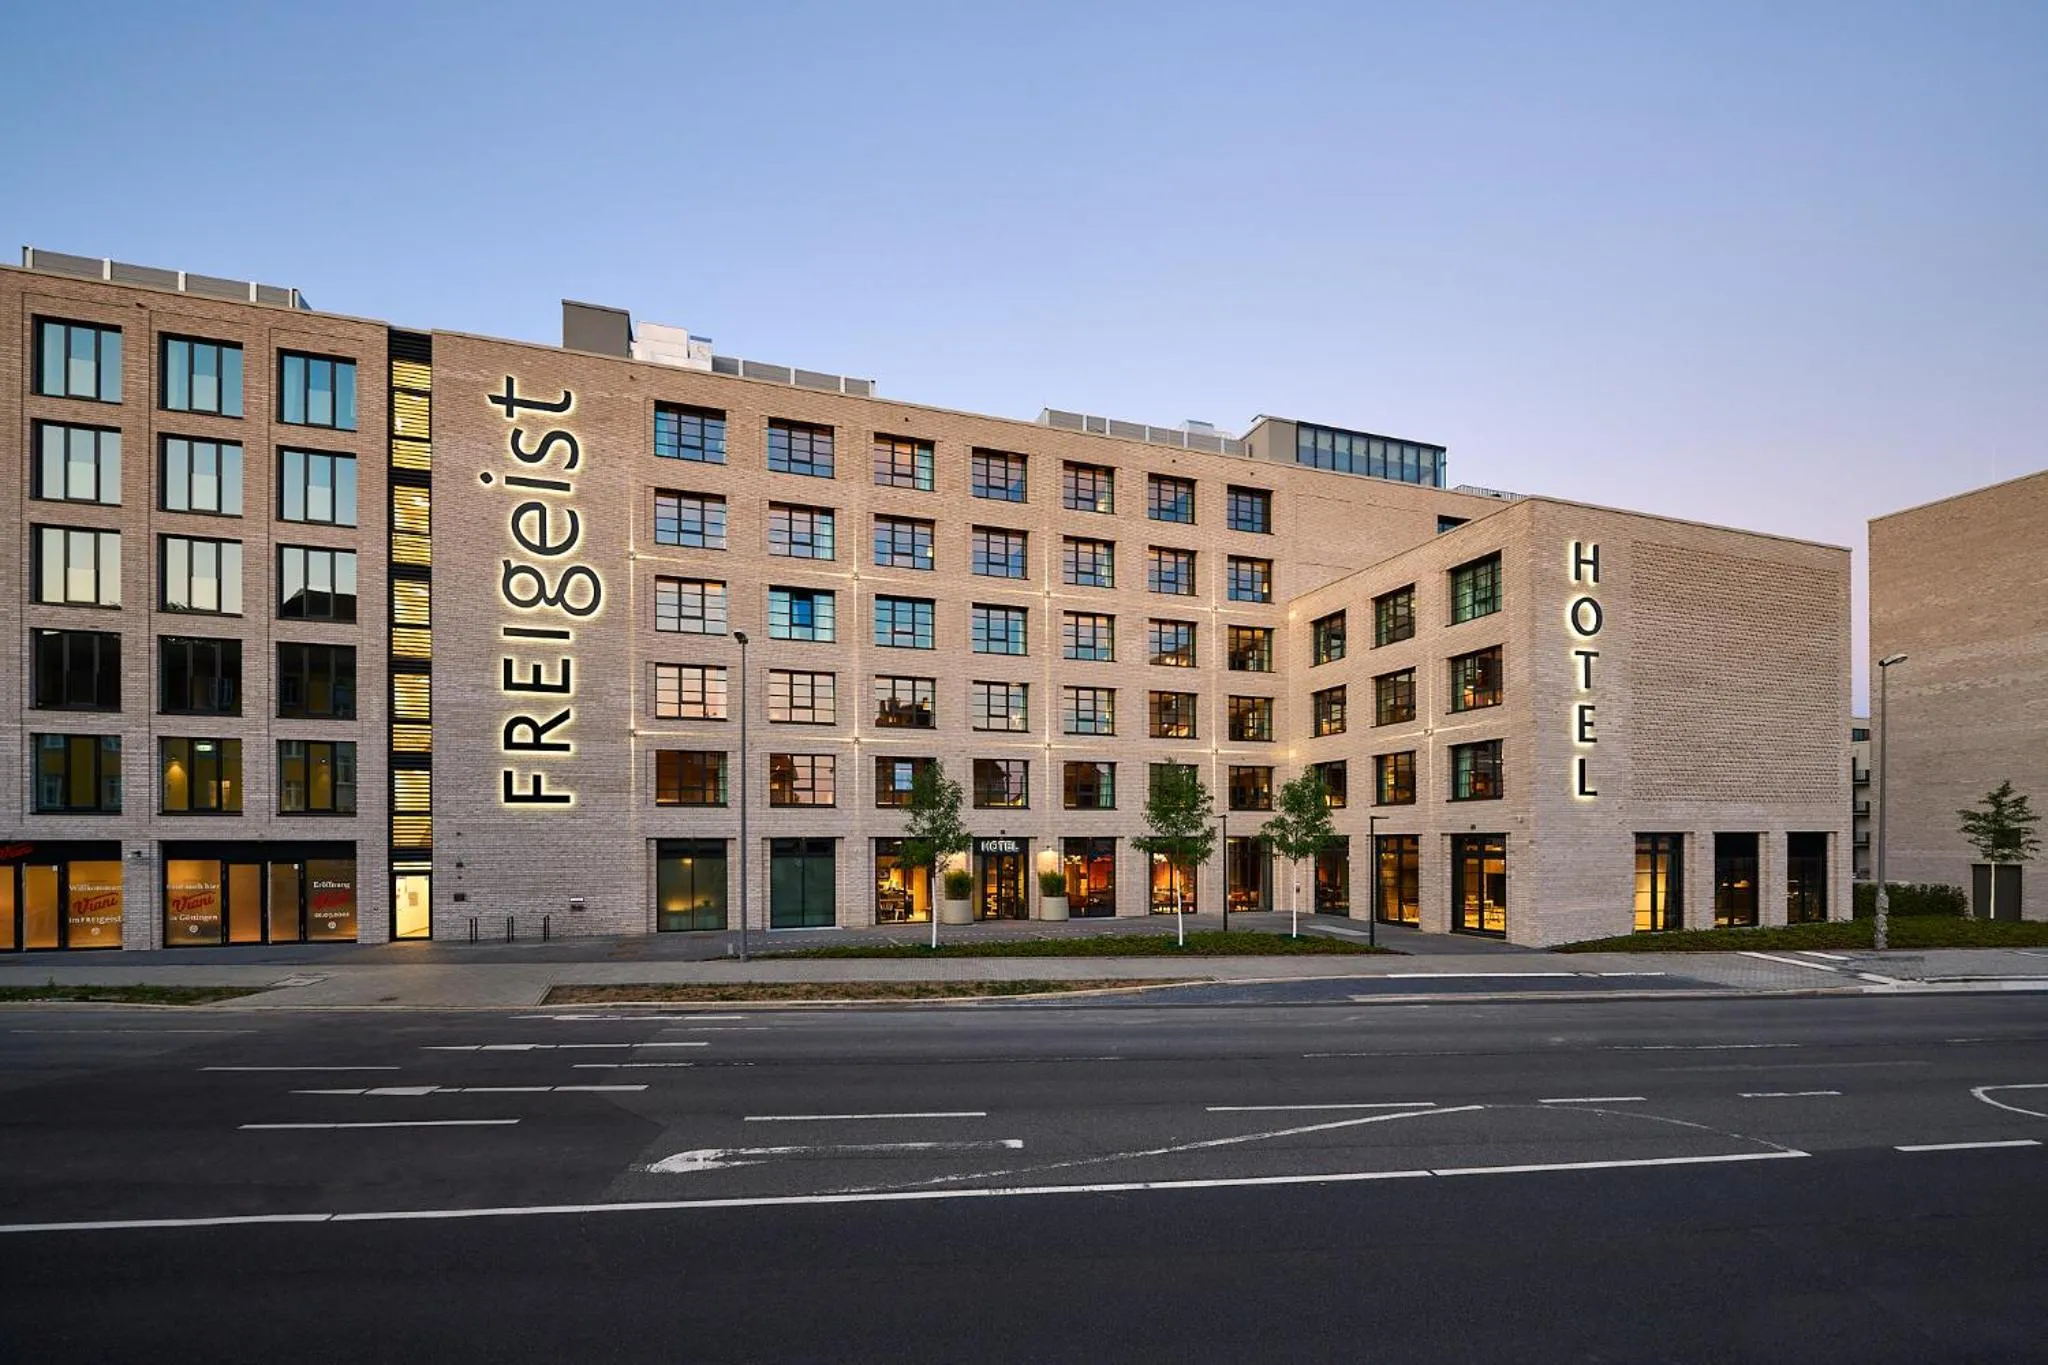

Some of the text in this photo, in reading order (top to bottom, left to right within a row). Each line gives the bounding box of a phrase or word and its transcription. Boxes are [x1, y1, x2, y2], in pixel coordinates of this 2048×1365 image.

[478, 374, 603, 805] FREIgeist
[1569, 540, 1604, 798] HOTEL
[981, 840, 1020, 852] HOTEL
